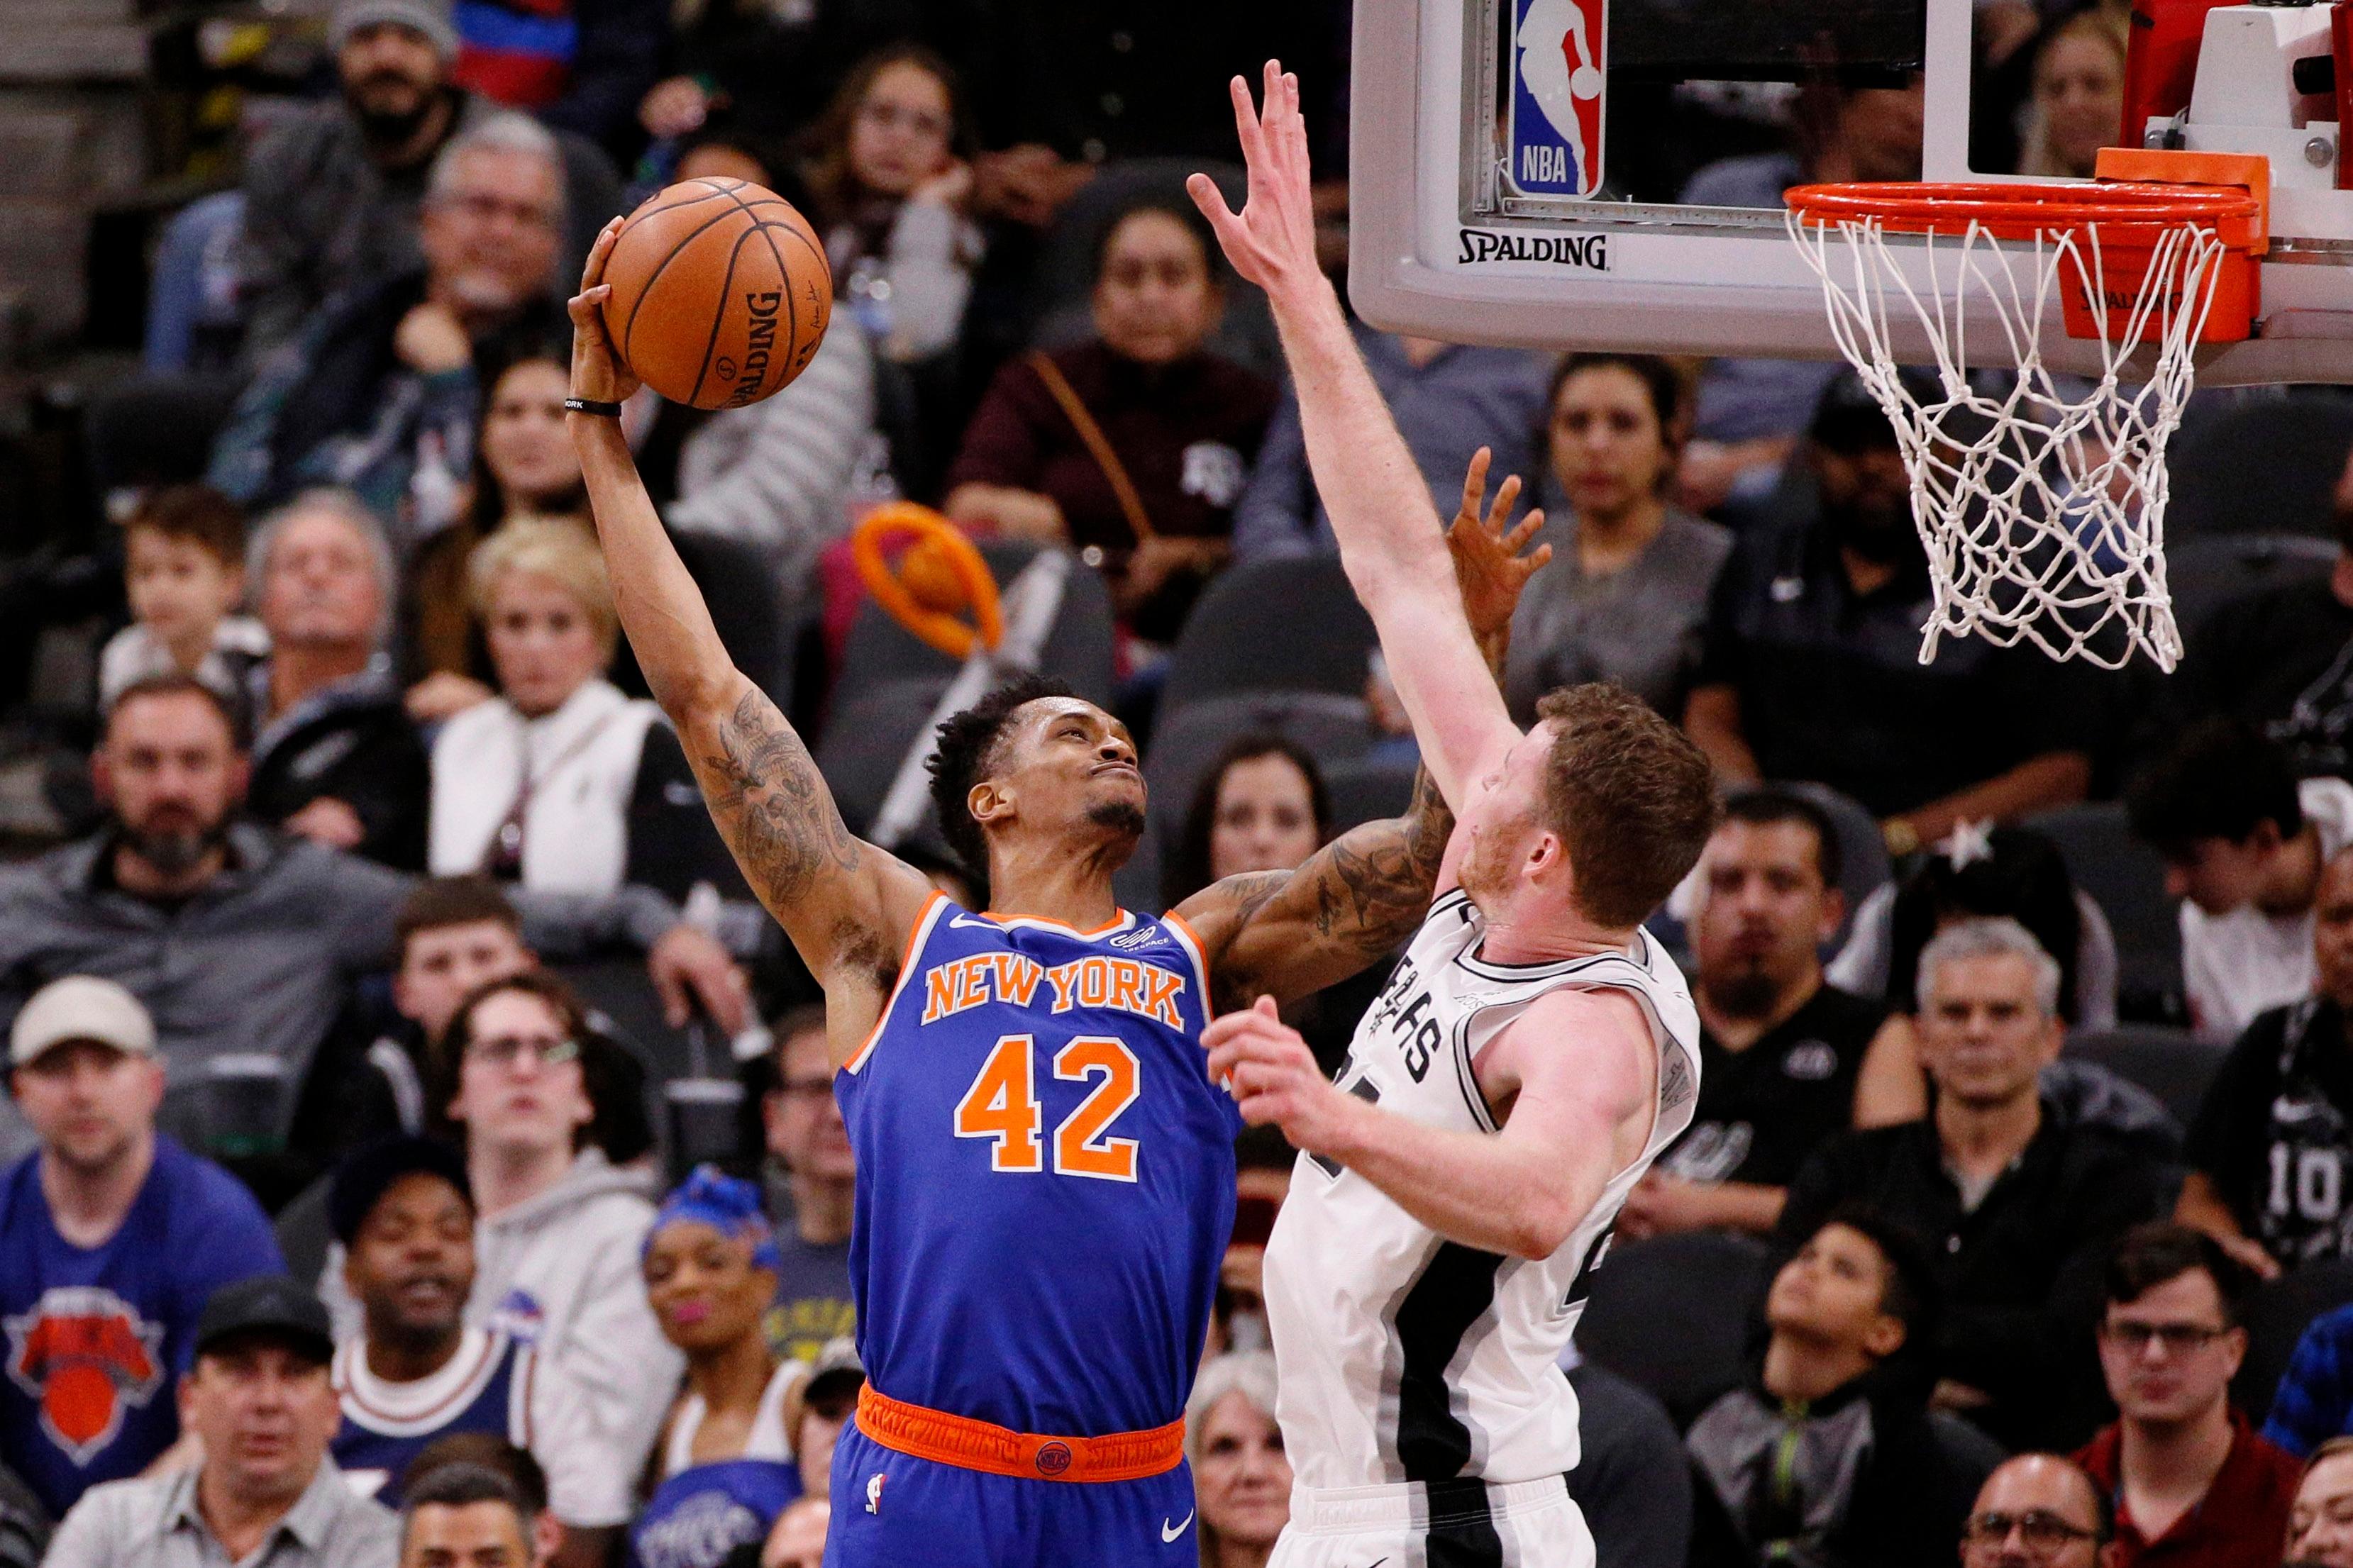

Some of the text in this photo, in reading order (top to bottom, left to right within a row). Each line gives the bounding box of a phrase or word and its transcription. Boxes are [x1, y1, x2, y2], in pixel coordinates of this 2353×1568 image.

[1522, 145, 1567, 184] NBA
[1458, 228, 1607, 271] SPALDING
[2080, 286, 2185, 316] SALDNG
[921, 952, 1186, 1034] NEW YORK
[953, 1033, 1141, 1183] 42
[2269, 1140, 2342, 1221] 10
